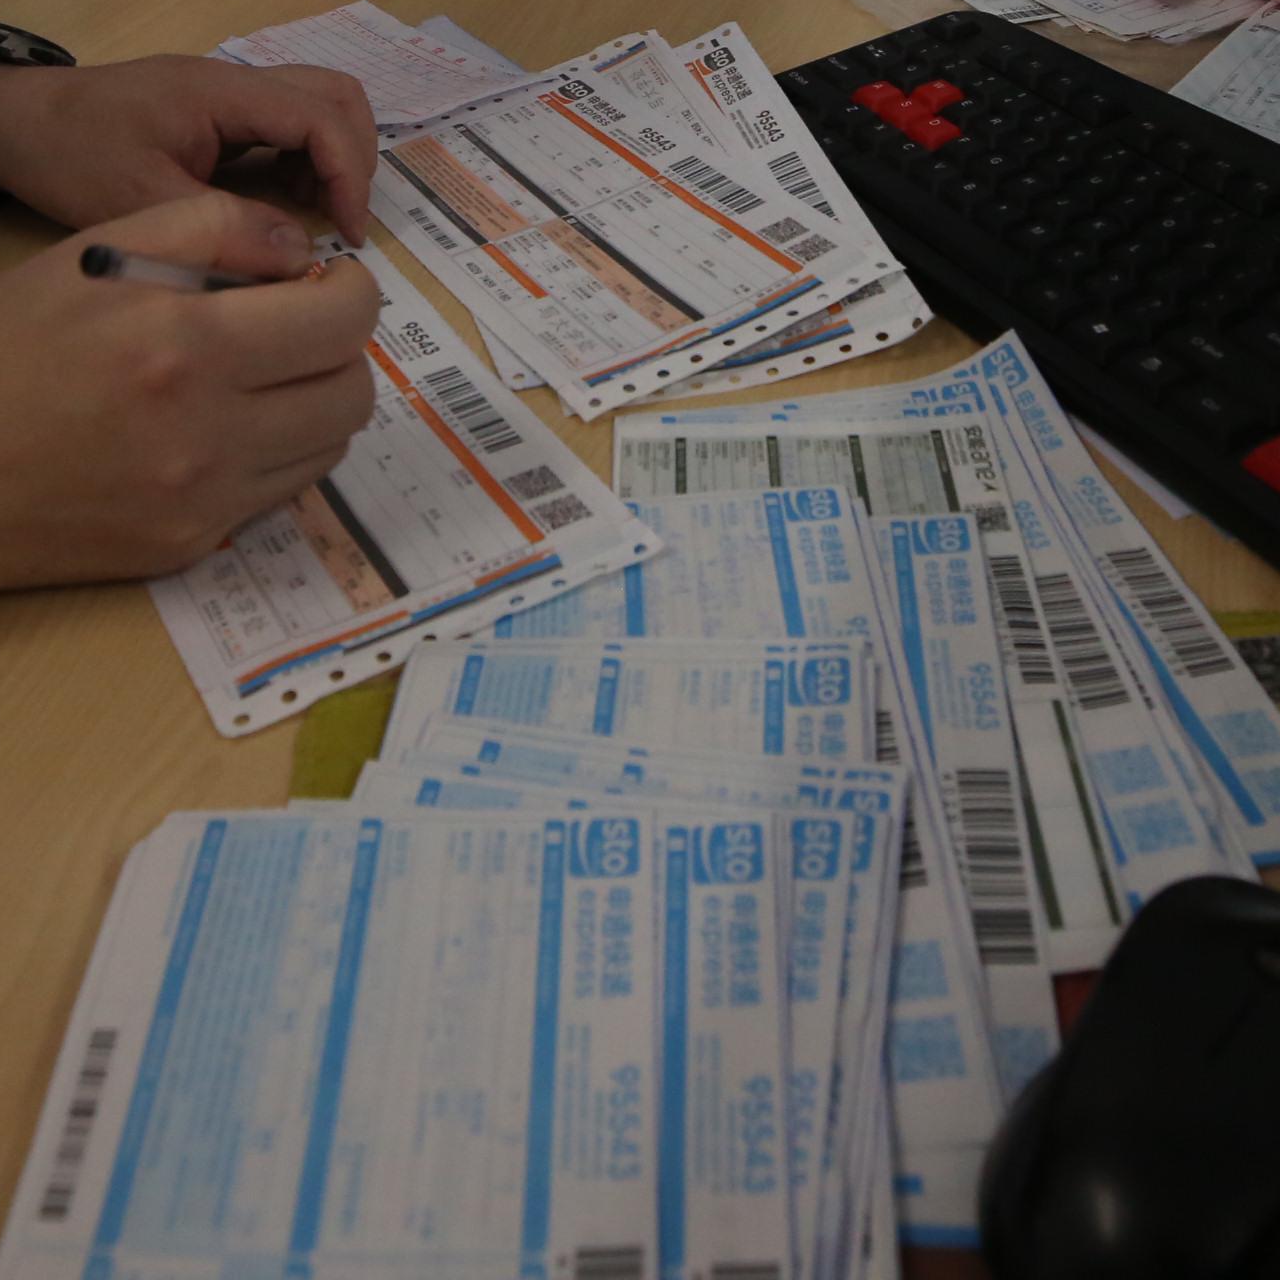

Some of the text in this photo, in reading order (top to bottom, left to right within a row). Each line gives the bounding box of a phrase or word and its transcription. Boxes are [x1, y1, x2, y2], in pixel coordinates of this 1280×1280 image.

[711, 49, 730, 68] sto
[564, 80, 589, 98] sto
[712, 74, 736, 106] express
[575, 102, 611, 127] express
[756, 110, 784, 142] 95543
[638, 127, 677, 152] 95543
[401, 321, 440, 356] 95543
[990, 349, 1020, 388] sto
[1078, 476, 1123, 525] 95543
[937, 519, 963, 552] sto
[817, 661, 844, 703] sto
[967, 662, 1001, 730] 95543
[601, 823, 633, 875] sto
[724, 824, 762, 880] sto
[800, 823, 832, 877] sto
[742, 1076, 777, 1196] 95543
